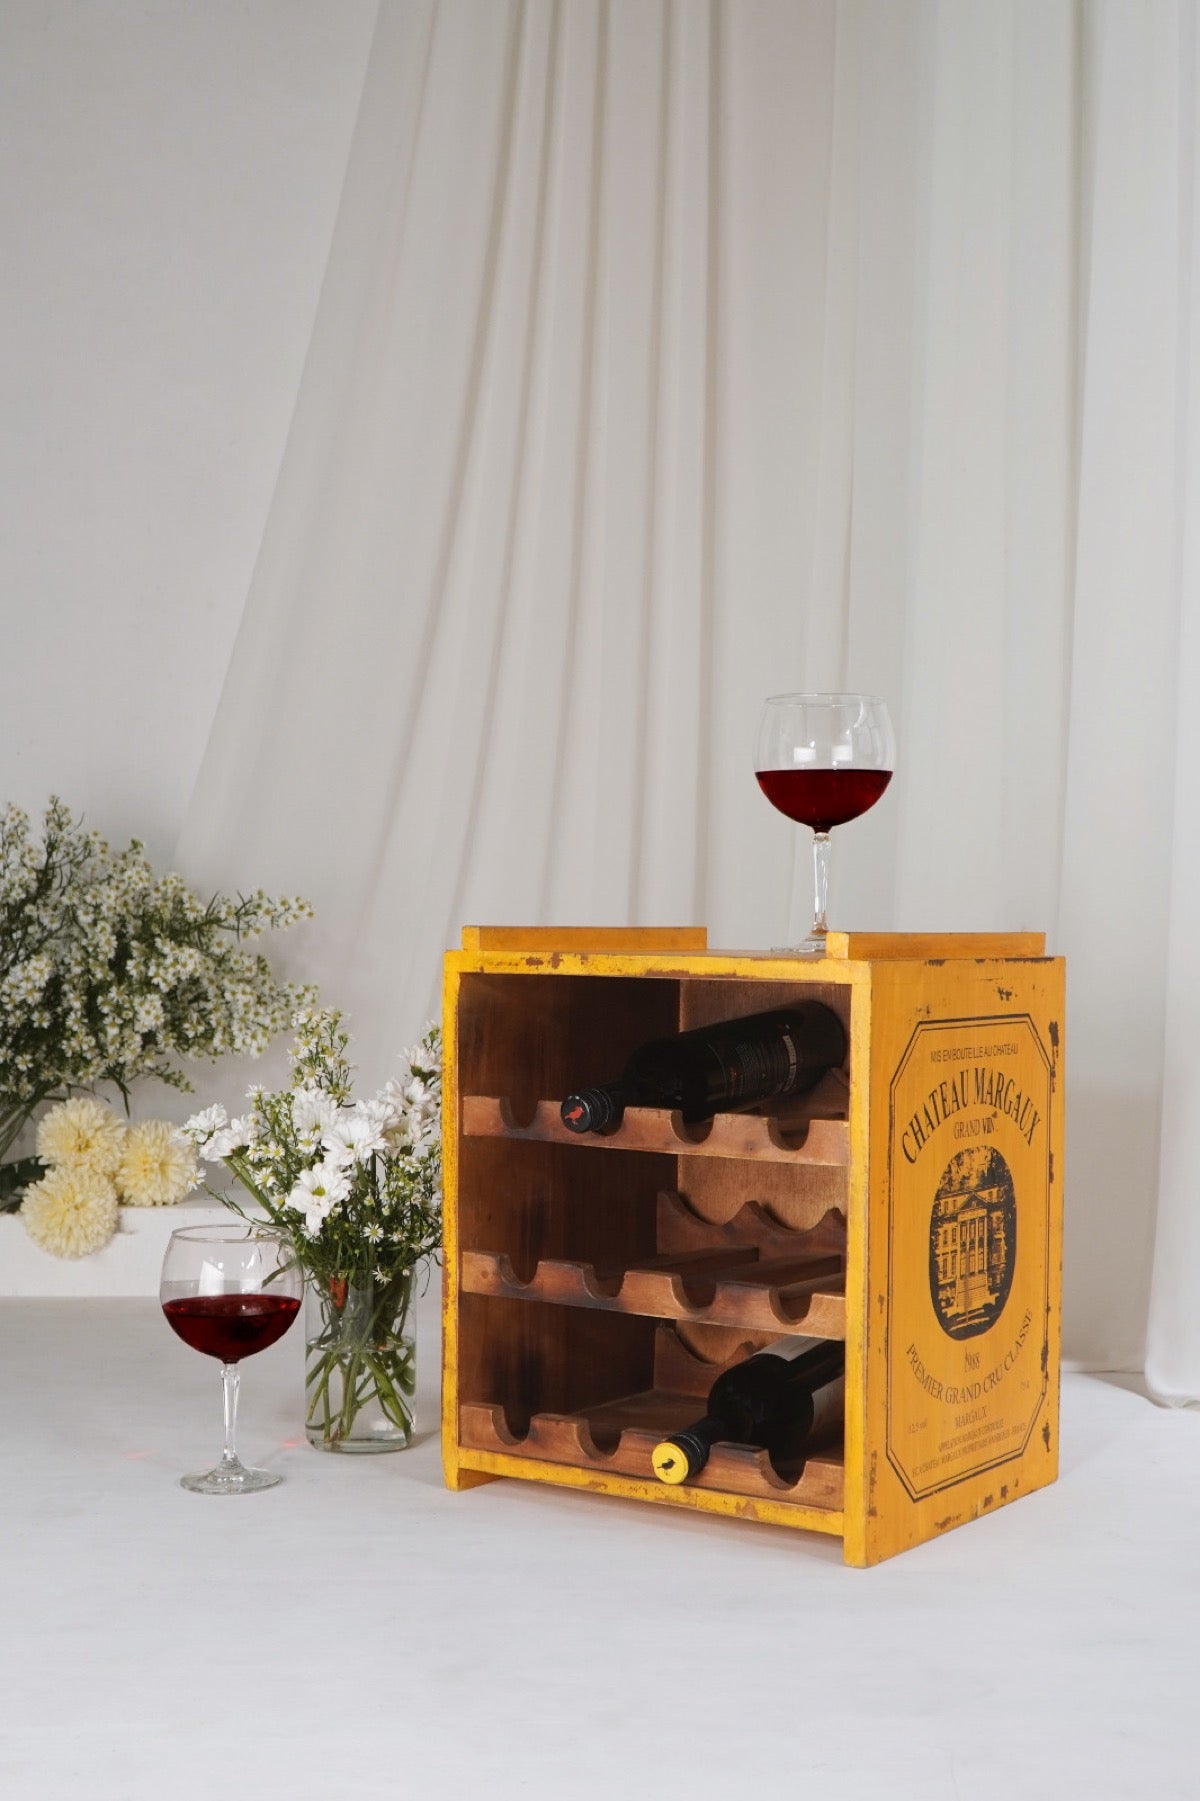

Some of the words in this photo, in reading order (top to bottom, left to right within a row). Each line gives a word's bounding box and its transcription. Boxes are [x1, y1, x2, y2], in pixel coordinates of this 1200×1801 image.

[902, 1069, 970, 1164] CHATEAU
[974, 1067, 1041, 1146] MARGAUX
[954, 1119, 980, 1140] GRAND
[906, 1344, 943, 1401] PREMIER
[945, 1385, 982, 1405] GRAND
[983, 1369, 1003, 1394] CRU
[955, 1406, 987, 1428] MARGAUX
